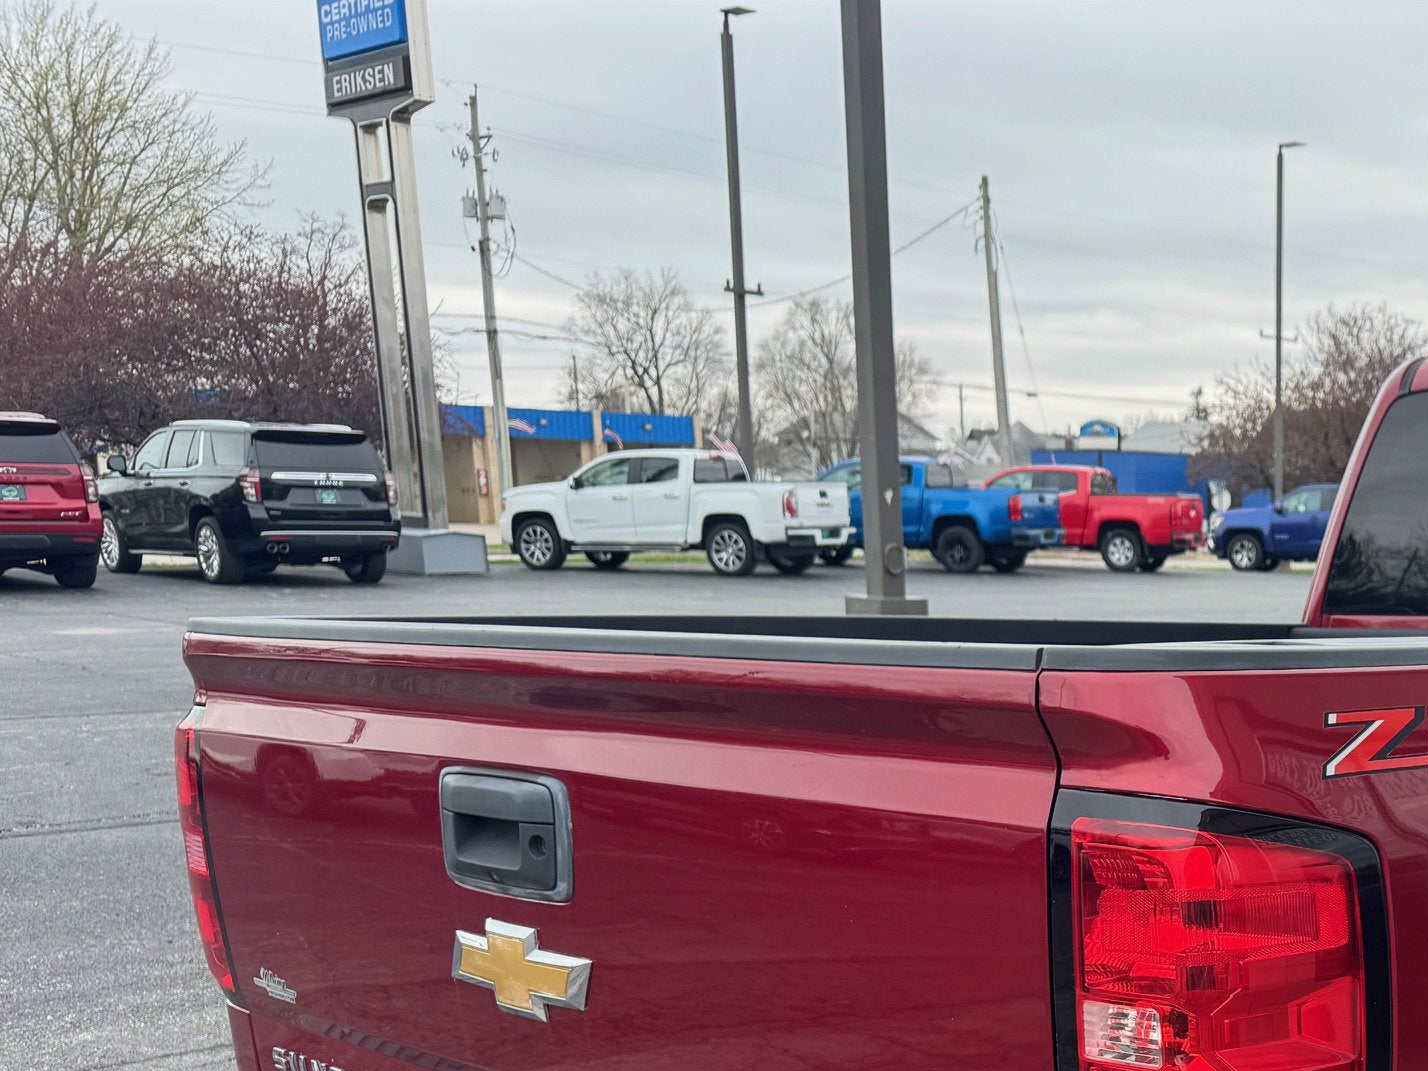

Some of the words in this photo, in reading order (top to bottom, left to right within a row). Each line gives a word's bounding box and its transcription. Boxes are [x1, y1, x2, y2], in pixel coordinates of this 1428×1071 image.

[321, 0, 394, 23] CERTIFI
[327, 8, 392, 42] PRE-OWNED
[333, 63, 394, 97] ERIKSEN
